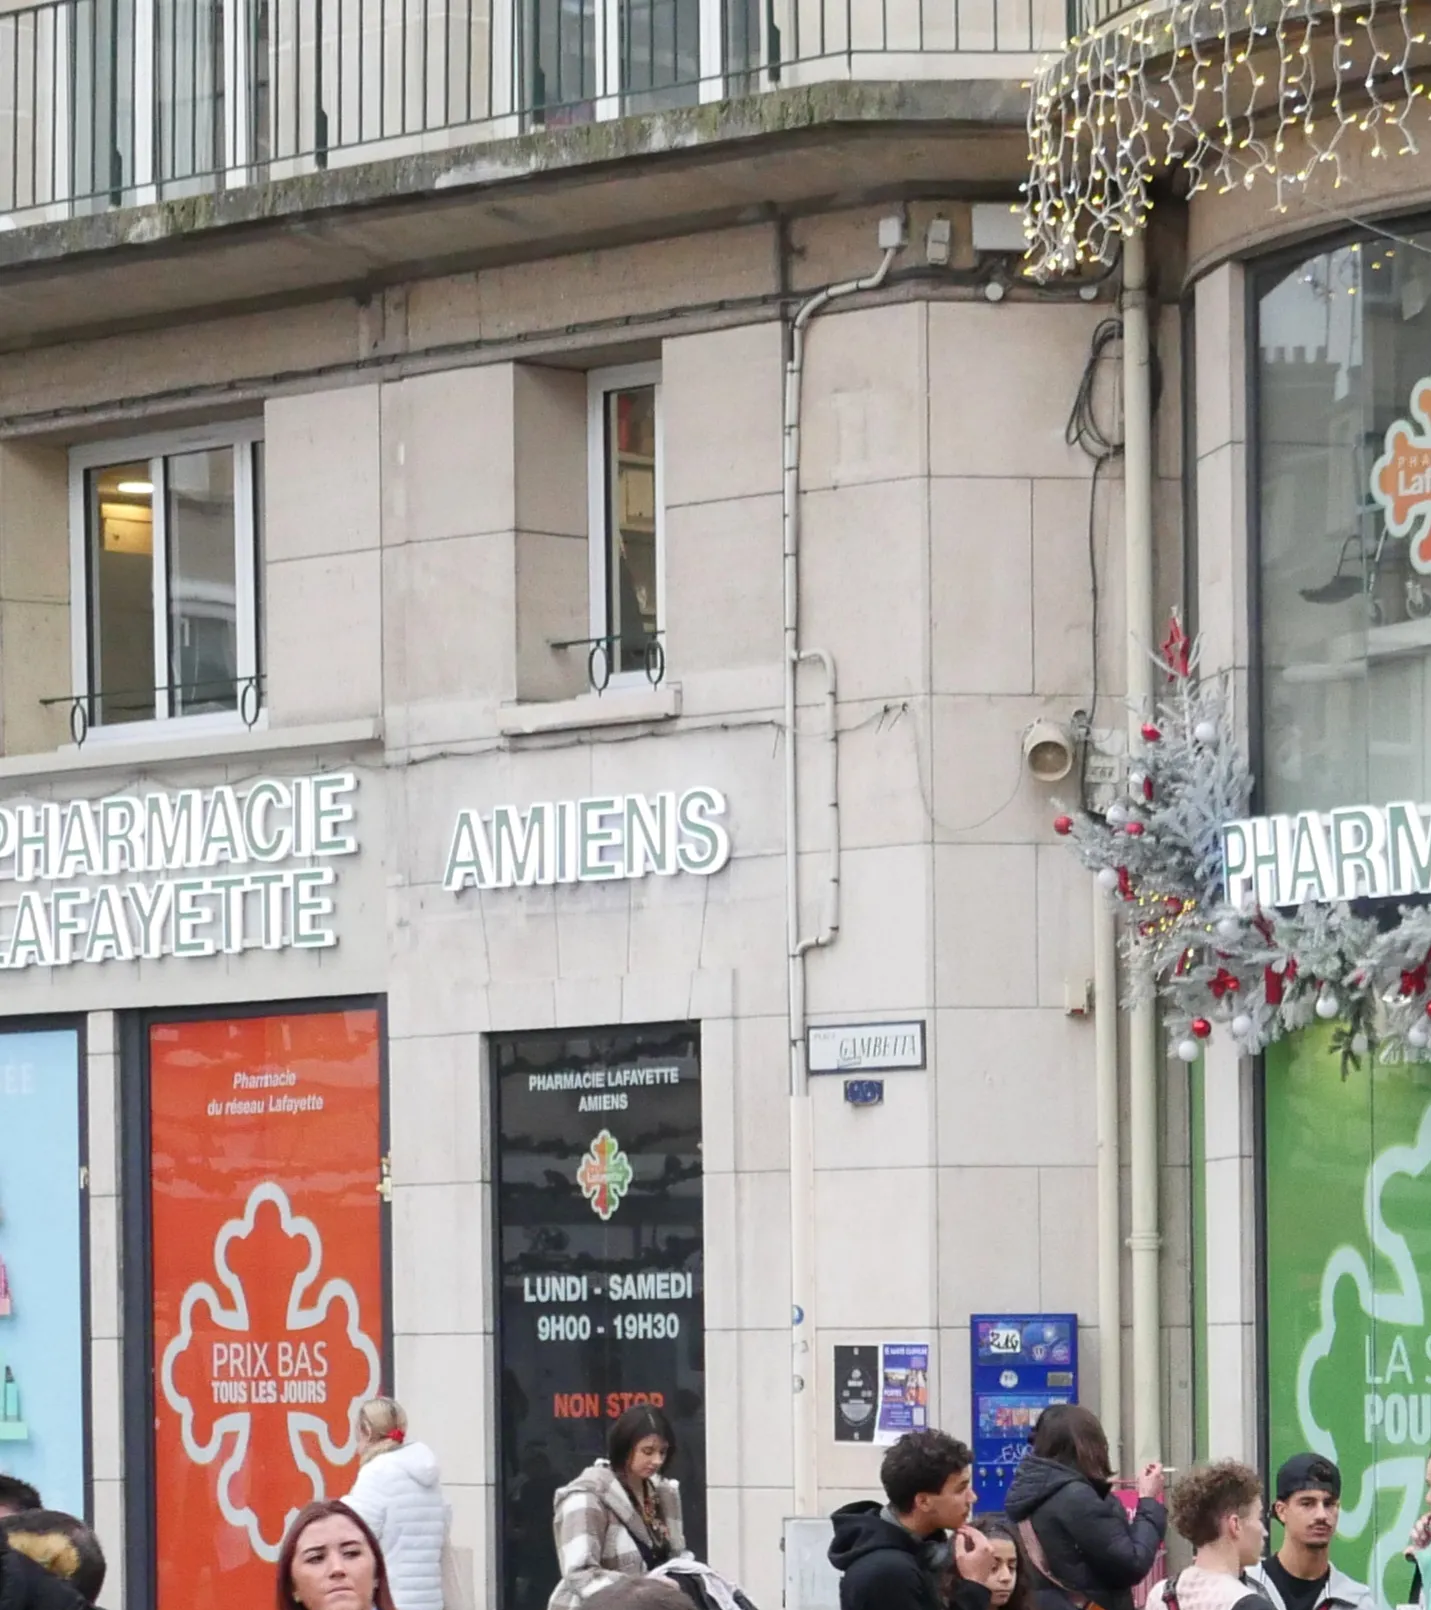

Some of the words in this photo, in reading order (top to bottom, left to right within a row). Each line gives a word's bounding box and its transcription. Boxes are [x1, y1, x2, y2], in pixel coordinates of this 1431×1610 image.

[443, 786, 730, 891] AMIENS
[0, 867, 338, 968] AFAYETTE
[233, 1071, 297, 1090] Pharmacie
[528, 1071, 605, 1091] PHARMACIE
[607, 1067, 680, 1087] LAFAYETTE
[207, 1099, 223, 1116] du
[225, 1096, 264, 1115] réseau
[268, 1093, 324, 1116] Lafayette
[578, 1092, 629, 1112] AMIENS
[523, 1275, 588, 1302] LUNDI
[609, 1272, 693, 1301] SAMEDI
[537, 1314, 591, 1341] 9H00
[613, 1312, 680, 1340] 19H30
[212, 1341, 271, 1378] PRIX
[277, 1340, 328, 1377] BAS
[1364, 1334, 1414, 1385] LA
[211, 1380, 248, 1404] TOUS
[251, 1380, 278, 1404] LES
[279, 1380, 327, 1404] JOURS
[553, 1392, 600, 1419] NON
